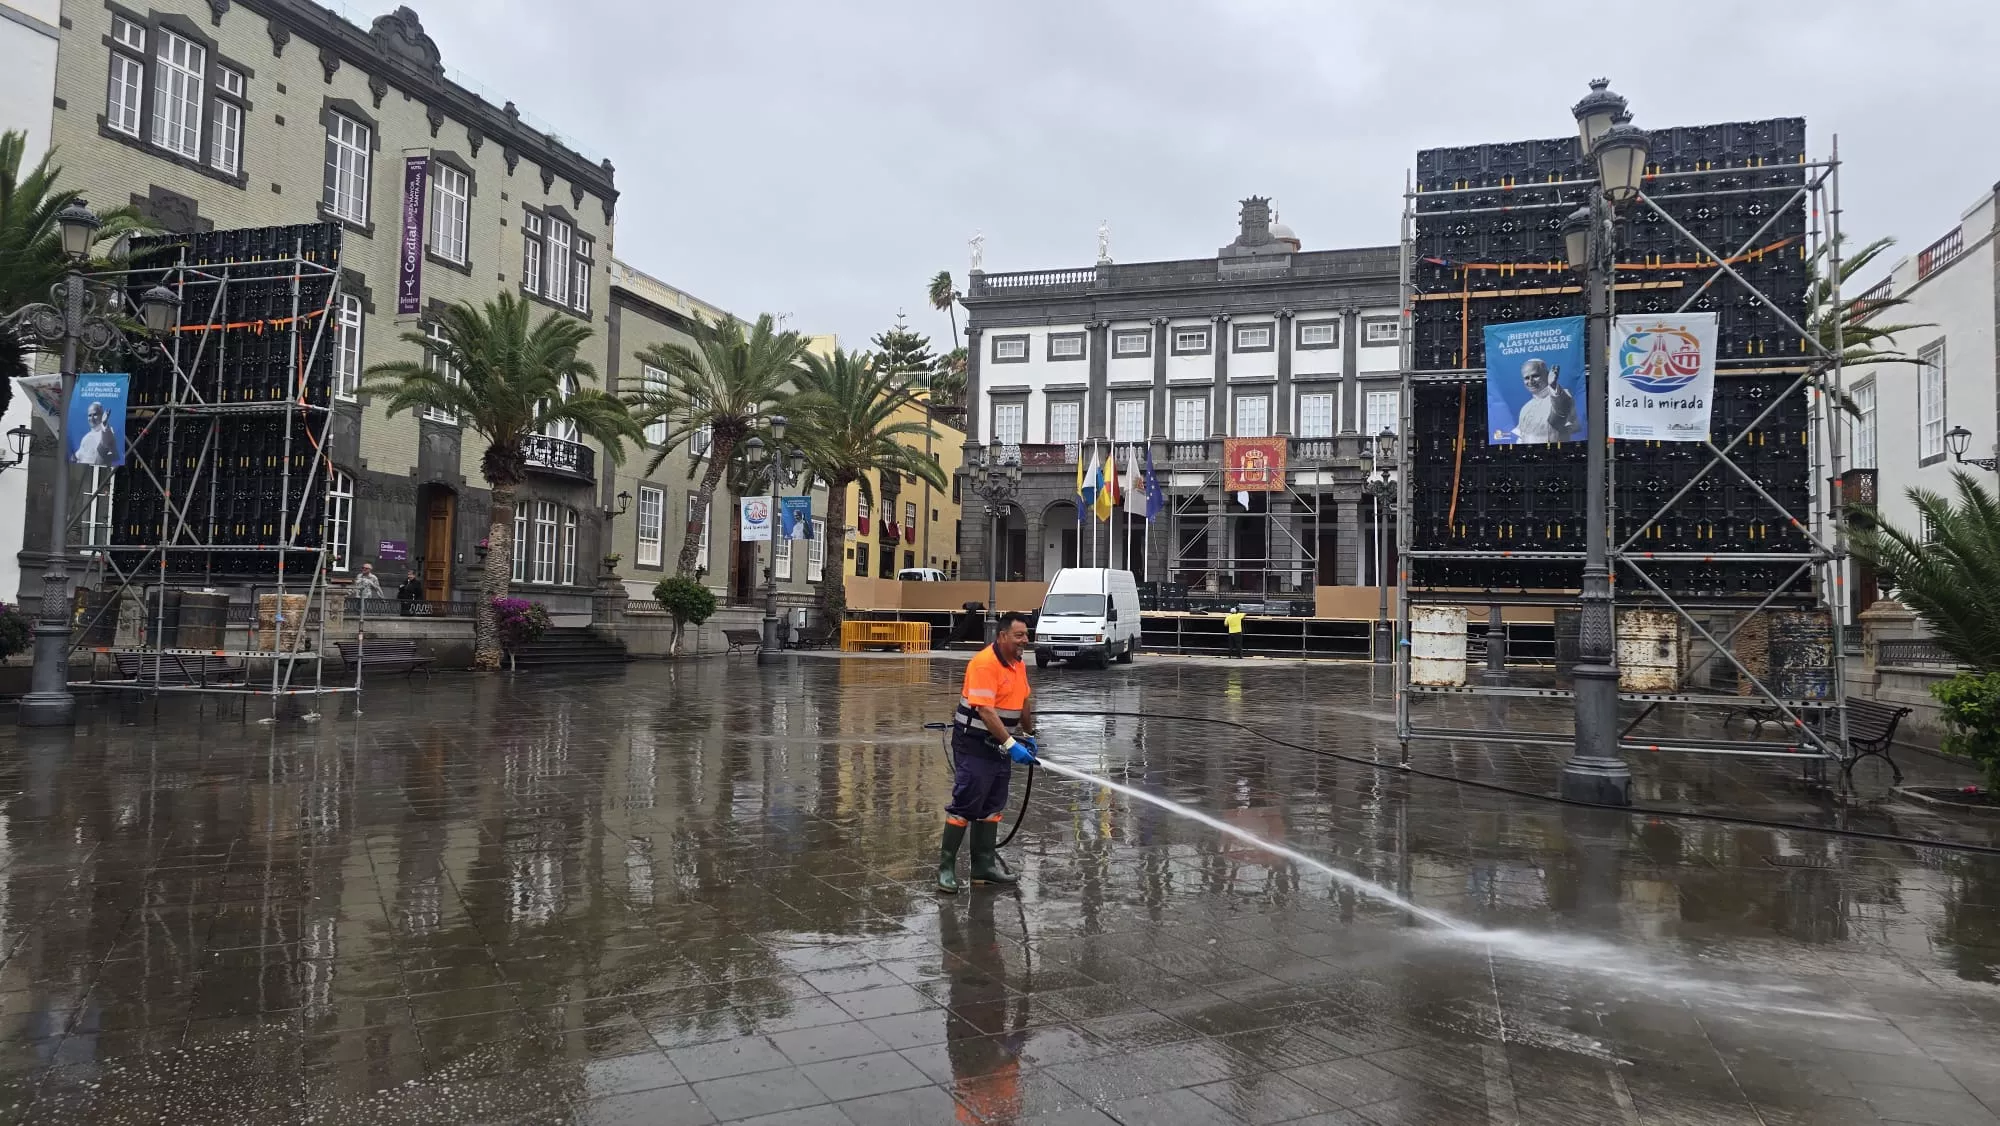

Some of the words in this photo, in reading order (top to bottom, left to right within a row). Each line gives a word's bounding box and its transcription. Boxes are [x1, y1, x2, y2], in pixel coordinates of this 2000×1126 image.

[404, 225, 417, 273] Cordial
[1507, 329, 1562, 341] ¡BIENVENIDO
[1502, 347, 1526, 355] GRAN
[1527, 342, 1569, 353] CANARIA!
[1506, 340, 1522, 348] LAS
[1524, 336, 1559, 346] PALMAS
[1614, 394, 1638, 408] alza
[1643, 395, 1654, 408] la
[1659, 394, 1704, 409] mirada
